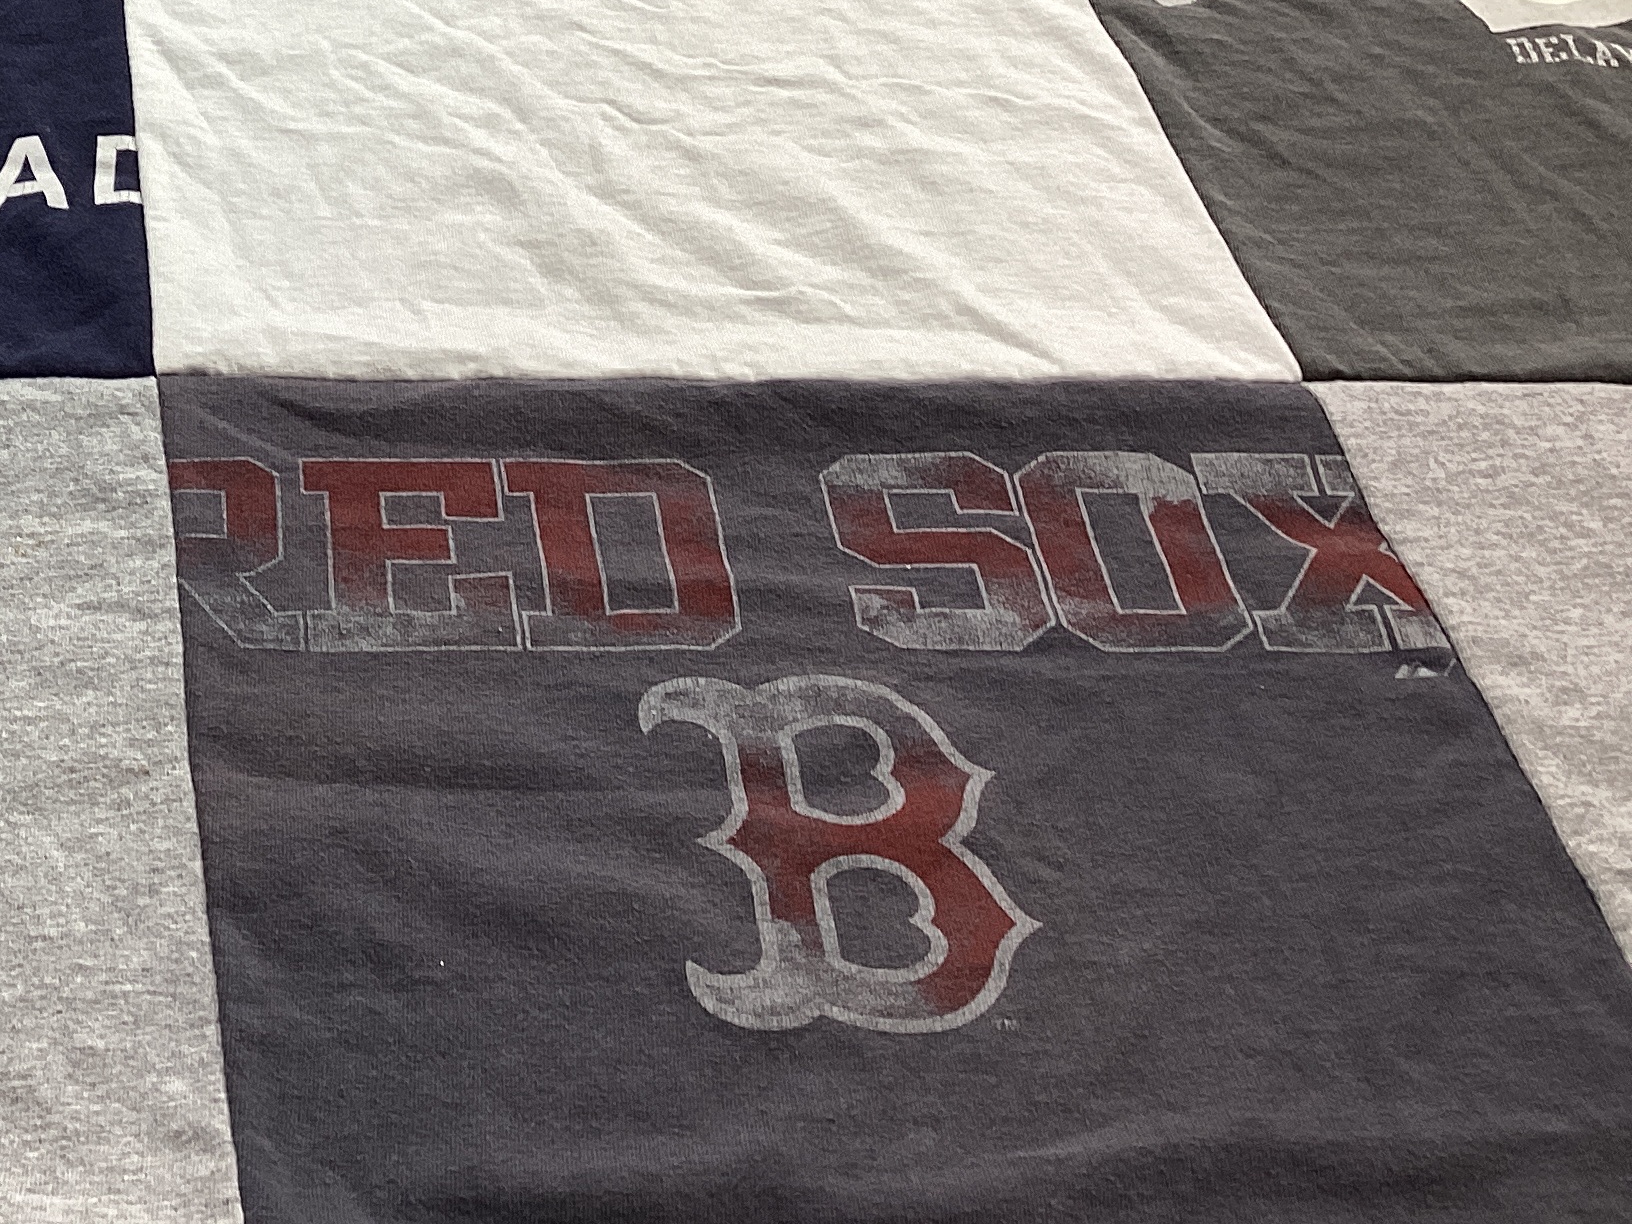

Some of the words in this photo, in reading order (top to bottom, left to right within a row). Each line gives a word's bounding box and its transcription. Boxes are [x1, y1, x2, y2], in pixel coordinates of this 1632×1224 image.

[171, 456, 741, 650] RED
[818, 451, 1456, 651] SOX
[638, 674, 1044, 1033] B
